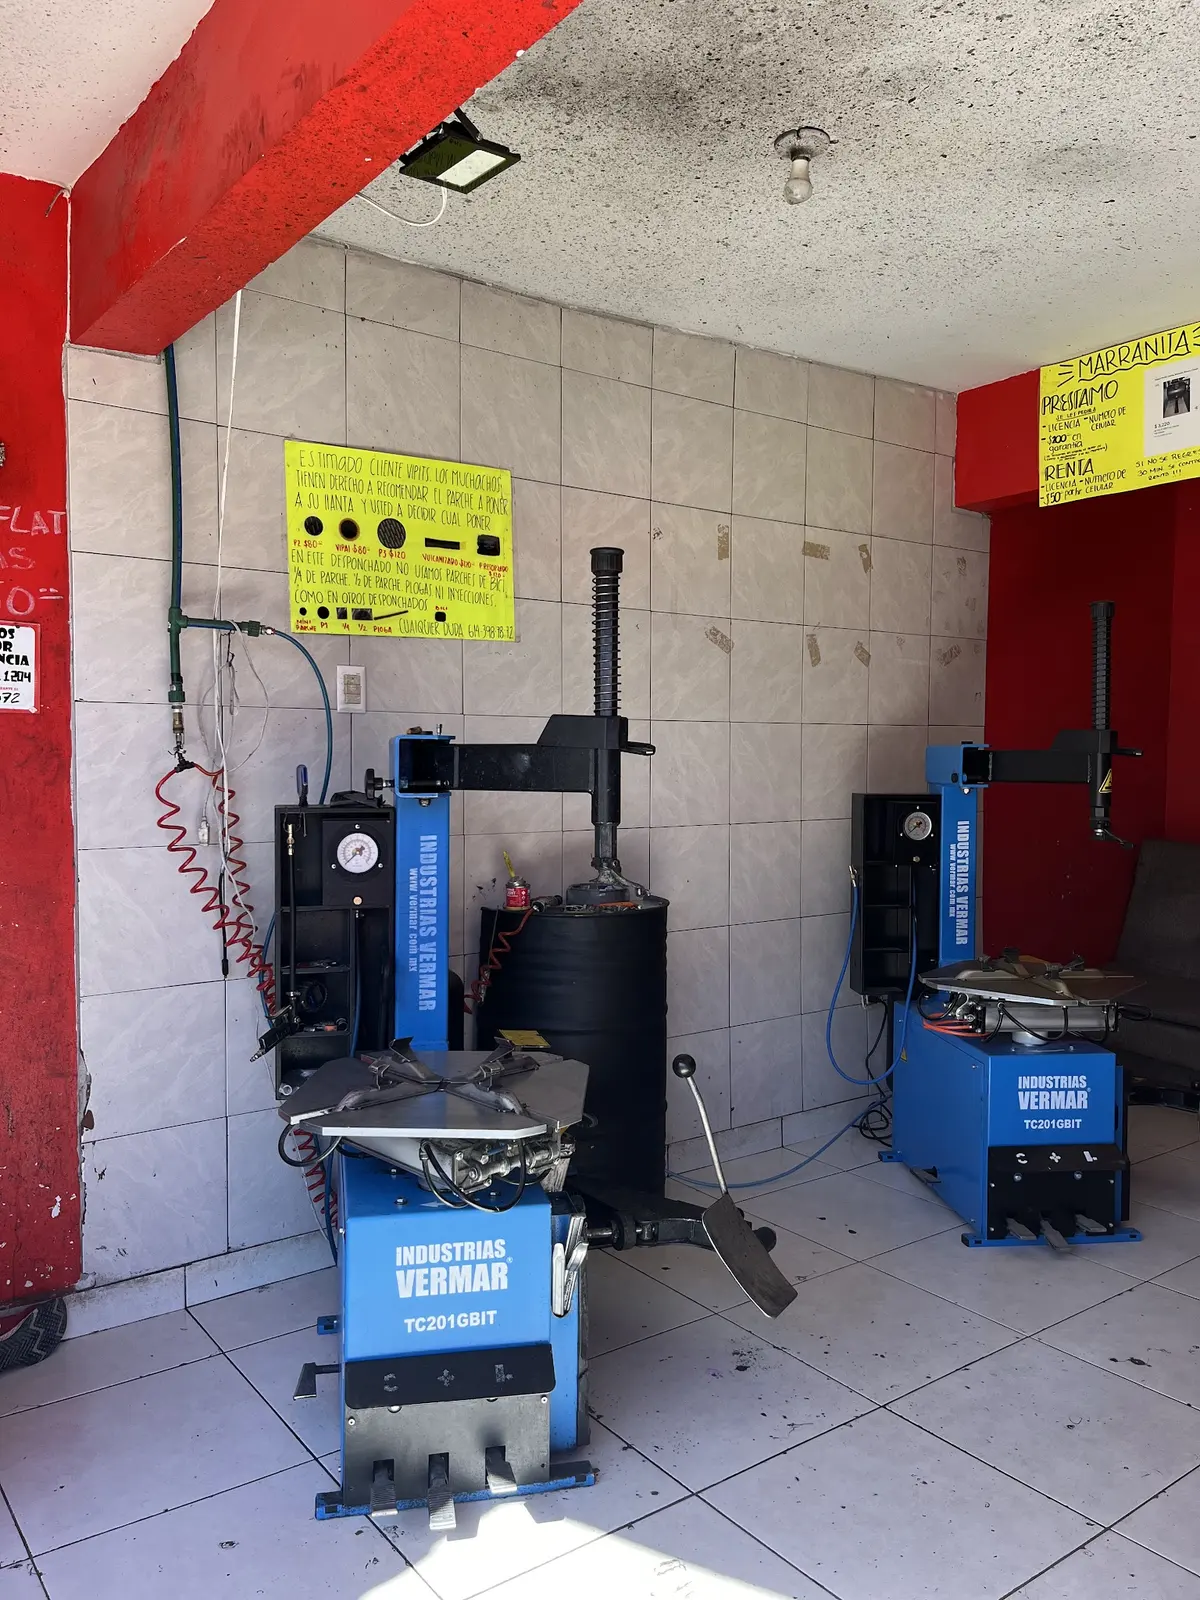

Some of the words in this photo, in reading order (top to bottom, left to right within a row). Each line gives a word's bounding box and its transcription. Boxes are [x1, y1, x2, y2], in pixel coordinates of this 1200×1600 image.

[1079, 330, 1189, 377] MARRANITA
[1041, 380, 1118, 415] PRESTAMO
[1048, 419, 1080, 432] LICENCIA
[1118, 406, 1126, 416] DE
[369, 458, 403, 479] CLIENTE
[435, 467, 448, 484] LOS
[1045, 458, 1094, 481] RENTA
[296, 469, 326, 489] TIENEN
[329, 473, 364, 495] DERECHO
[367, 480, 373, 495] A
[377, 481, 428, 502] RECOMENDAR
[434, 488, 442, 505] EL
[447, 489, 473, 510] PARCHE
[478, 495, 483, 510] A
[486, 495, 509, 516] PONER
[1045, 479, 1076, 492] LICENCIA
[295, 491, 302, 508] A
[307, 492, 320, 510] SU
[324, 494, 354, 513] LLANTA
[361, 498, 367, 515] Y
[370, 499, 393, 517] USTED
[397, 503, 403, 518] A
[407, 504, 436, 524] DECIDIR
[441, 509, 461, 527] CUAL
[466, 512, 491, 531] PONER
[291, 548, 304, 563] EN
[307, 552, 324, 566] ESTE
[331, 553, 392, 574] DESPONCHADO
[396, 561, 409, 576] NO
[414, 564, 443, 582] USAMOS
[446, 568, 475, 587] PARCHES
[479, 574, 486, 589] DE
[378, 548, 386, 558] P3
[389, 548, 406, 560] $120
[306, 569, 316, 584] DE
[363, 574, 372, 589] DE
[435, 585, 444, 600] NI
[294, 588, 324, 604] COMO
[327, 590, 338, 603] EN
[341, 592, 366, 606] OTROS
[368, 592, 428, 611] DESPONCHADOS
[398, 617, 441, 636] CUALQUIER
[442, 622, 464, 637] DUDA
[957, 820, 970, 893] INDUSTRIAS
[419, 834, 438, 937] INDUSTRIAS
[956, 896, 969, 945] VERMAR
[418, 941, 437, 1011] VERMAR
[1018, 1075, 1087, 1089] INDUSTRIAS
[1017, 1090, 1088, 1110] VERMAR
[1023, 1118, 1082, 1130] TC201GBIT
[395, 1238, 506, 1267] INDUSTRIAS
[395, 1262, 508, 1299] VERMAR
[404, 1310, 498, 1333] TC201GBIT
